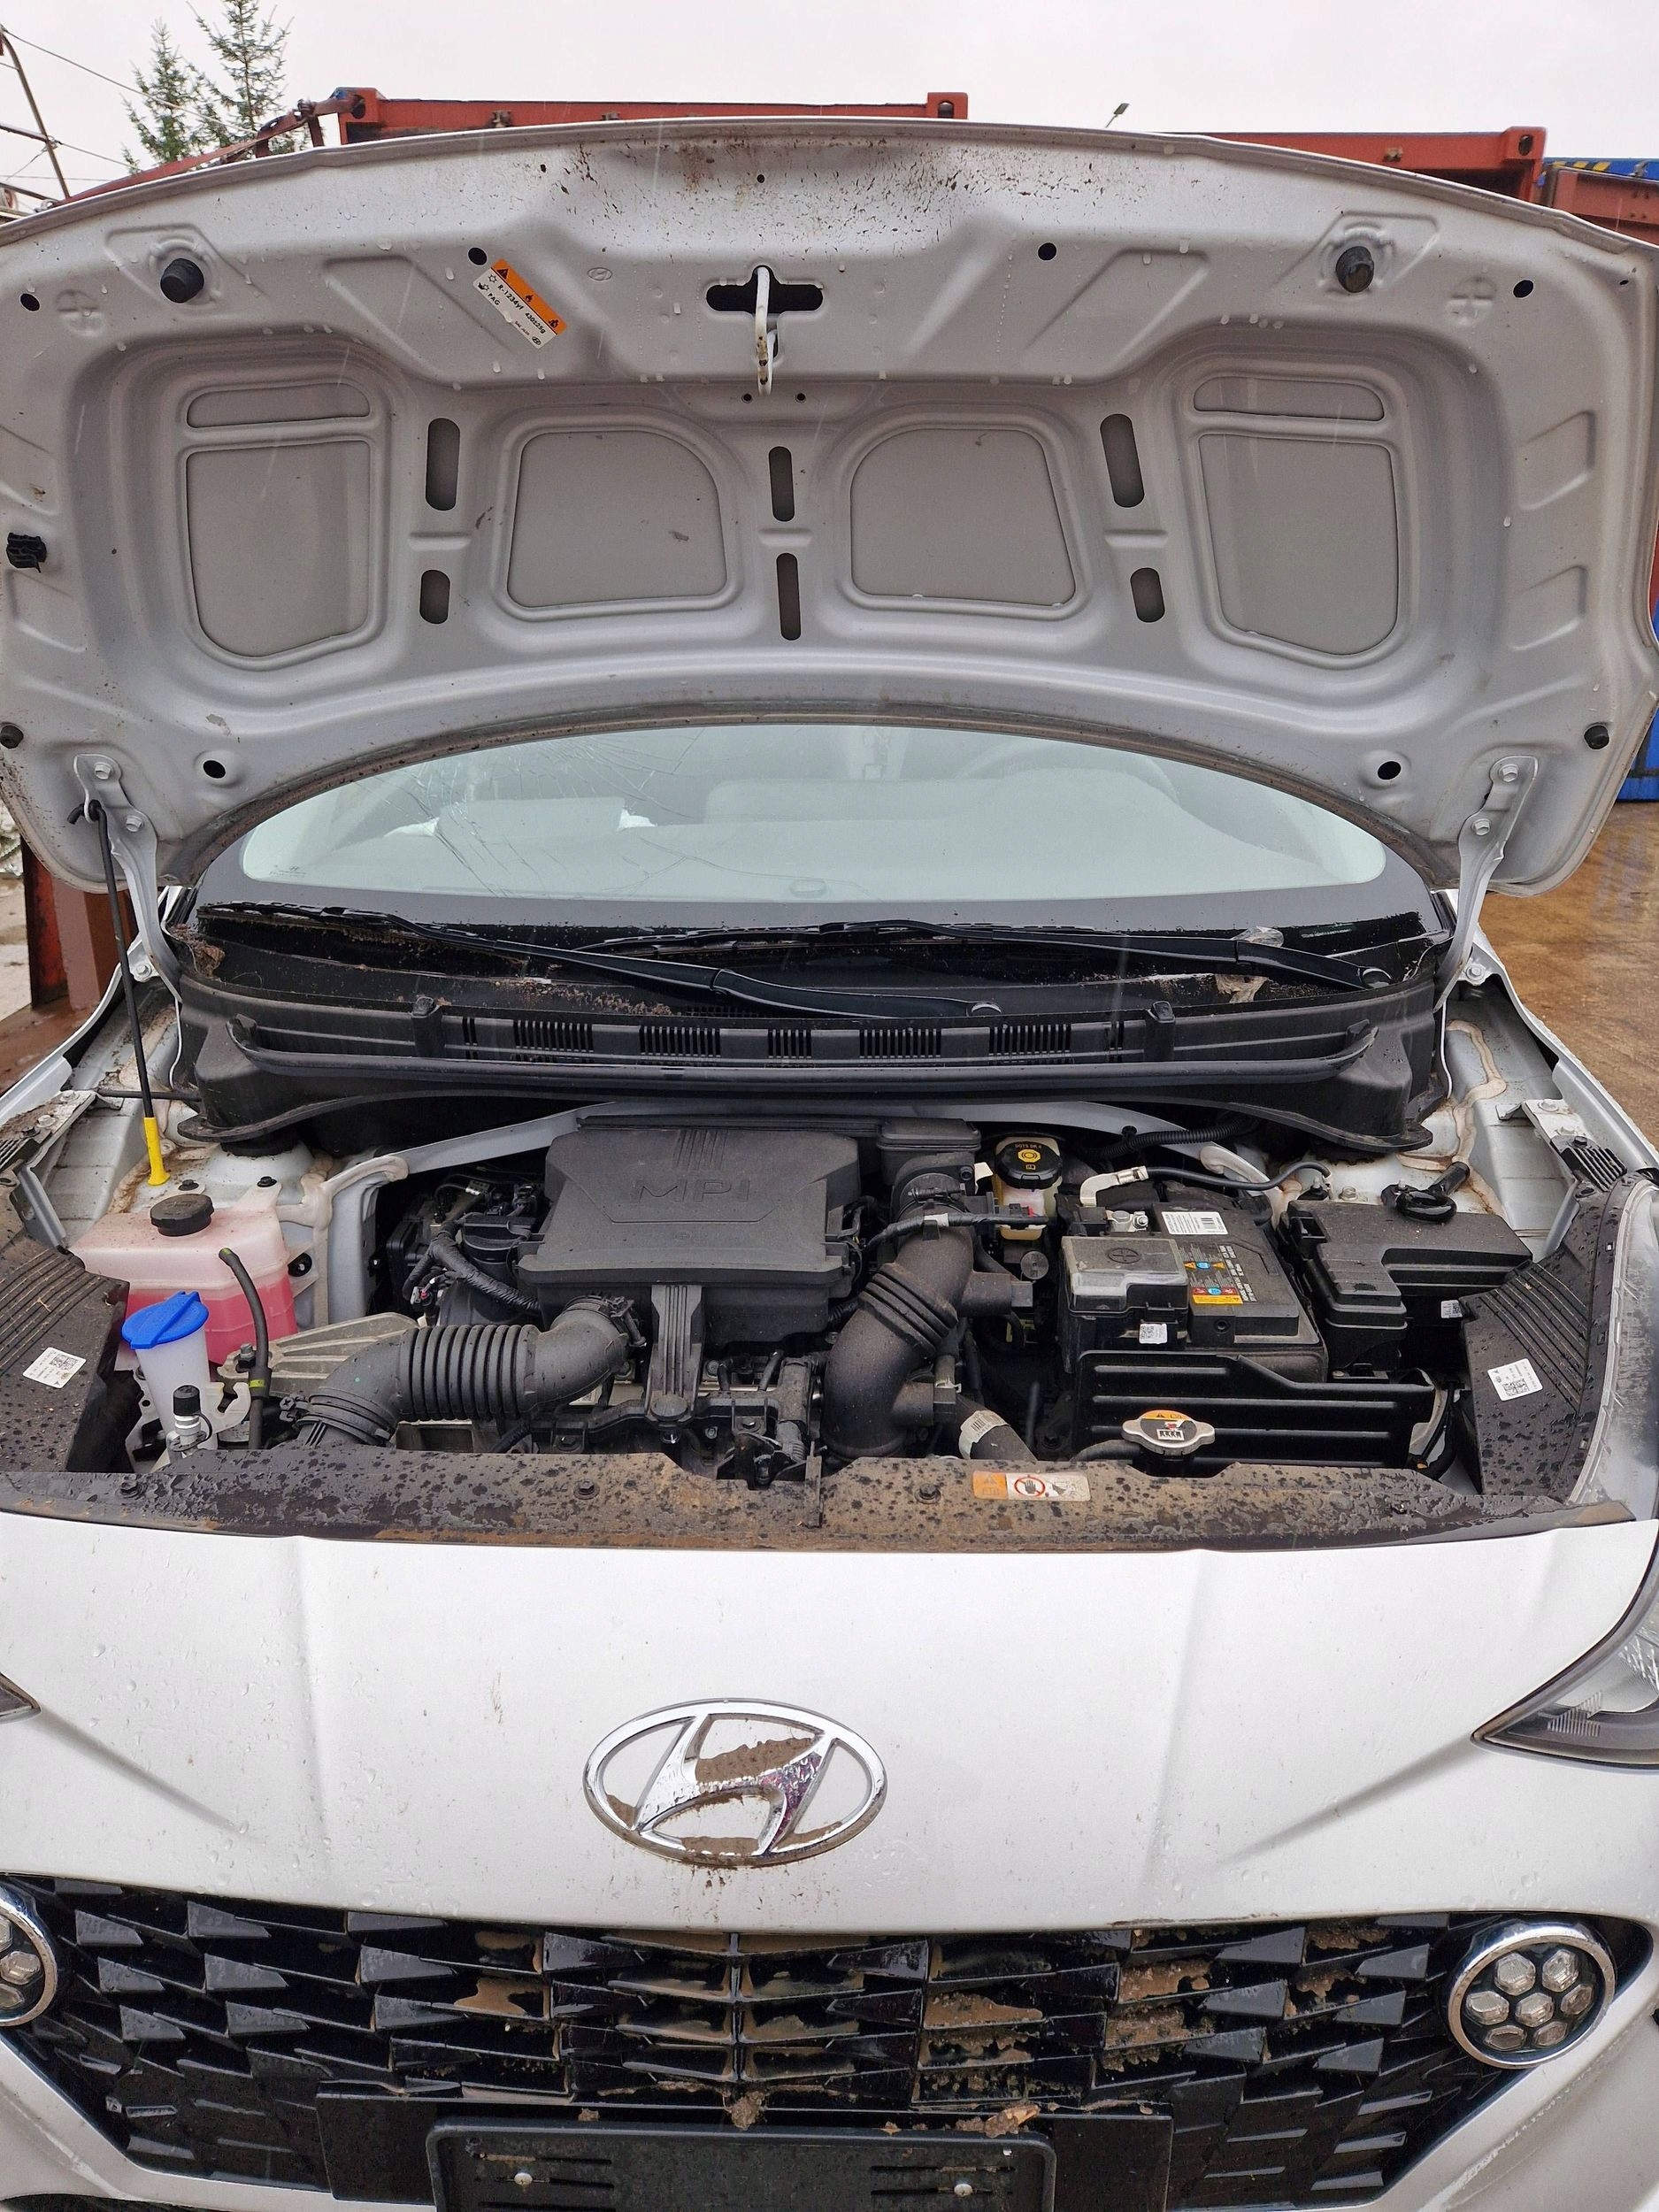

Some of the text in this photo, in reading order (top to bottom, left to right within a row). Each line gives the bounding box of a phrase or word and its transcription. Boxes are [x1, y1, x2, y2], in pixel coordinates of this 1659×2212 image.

[488, 293, 501, 305] PAG
[497, 284, 547, 334] R-1234yf 430±25g
[629, 1179, 751, 1203] MPI
